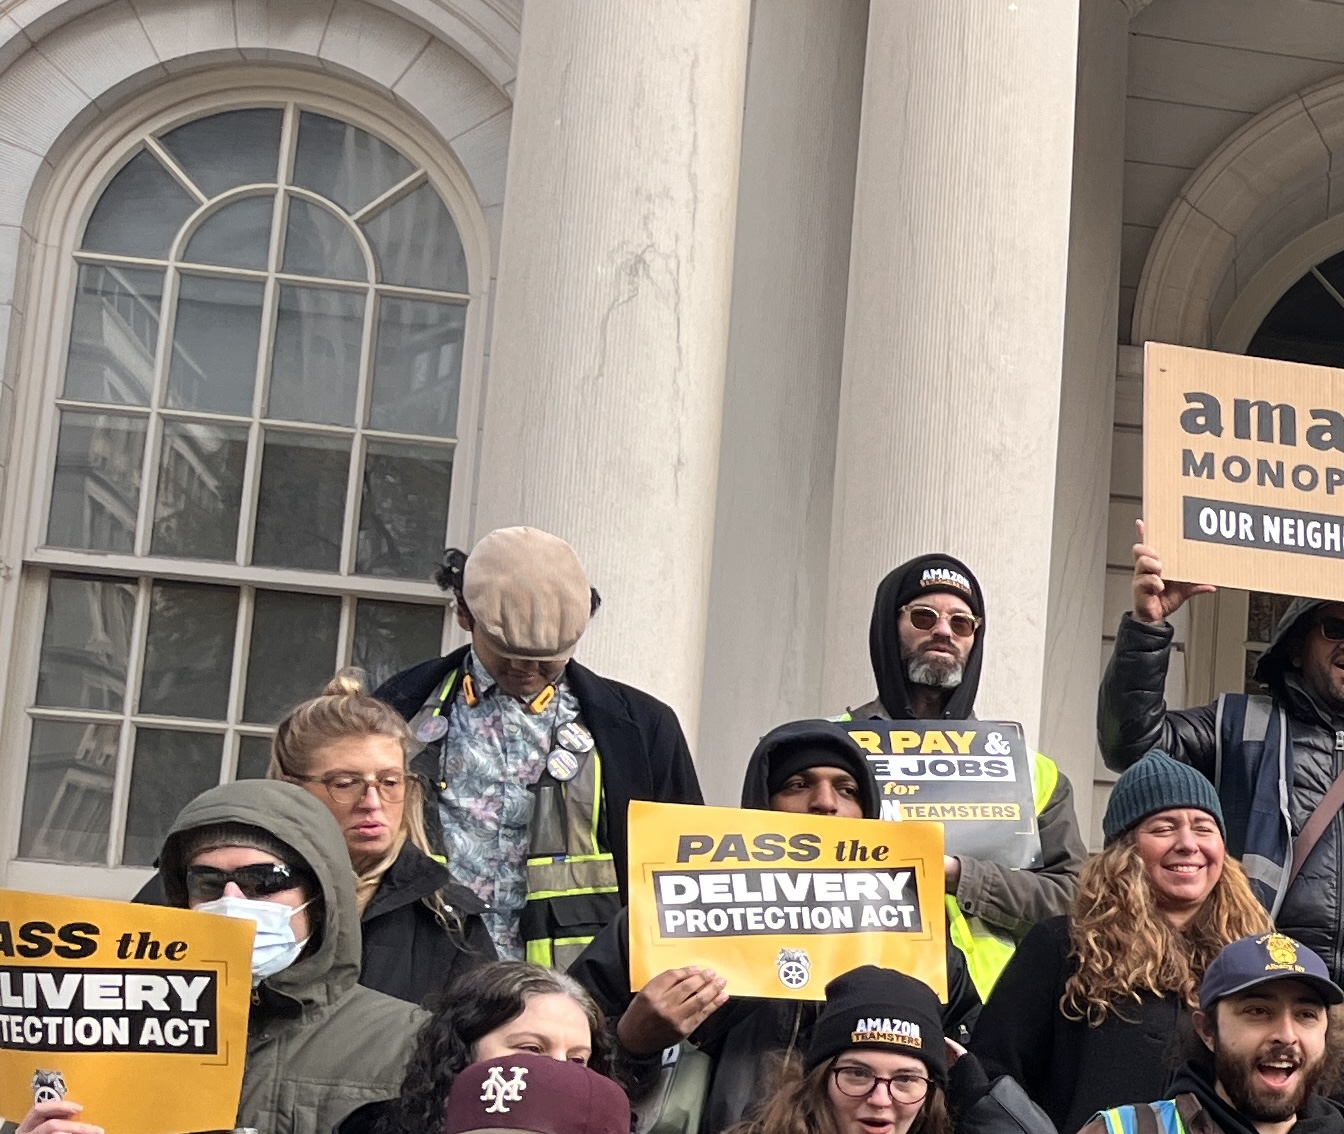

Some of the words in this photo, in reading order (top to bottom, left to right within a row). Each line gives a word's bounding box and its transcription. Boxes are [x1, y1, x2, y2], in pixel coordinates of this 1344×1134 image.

[1200, 507, 1254, 542] OUR
[921, 568, 972, 590] AMAZON
[889, 730, 977, 755] PAY
[984, 731, 1011, 755] &
[901, 759, 1010, 778] JOBS
[883, 781, 920, 796] for
[903, 805, 1016, 818] TEAMSTERS
[676, 833, 822, 864] PASS
[833, 839, 890, 863] the
[659, 871, 912, 905] DELIVERY
[664, 905, 855, 934] PROTECTION
[860, 904, 915, 929] ACT
[0, 921, 100, 960] SS
[116, 930, 189, 962] the
[0, 971, 212, 1013] LIVERY
[0, 1015, 134, 1046] TECTION
[139, 1019, 210, 1048] ACT
[856, 1017, 921, 1038] AMAZON
